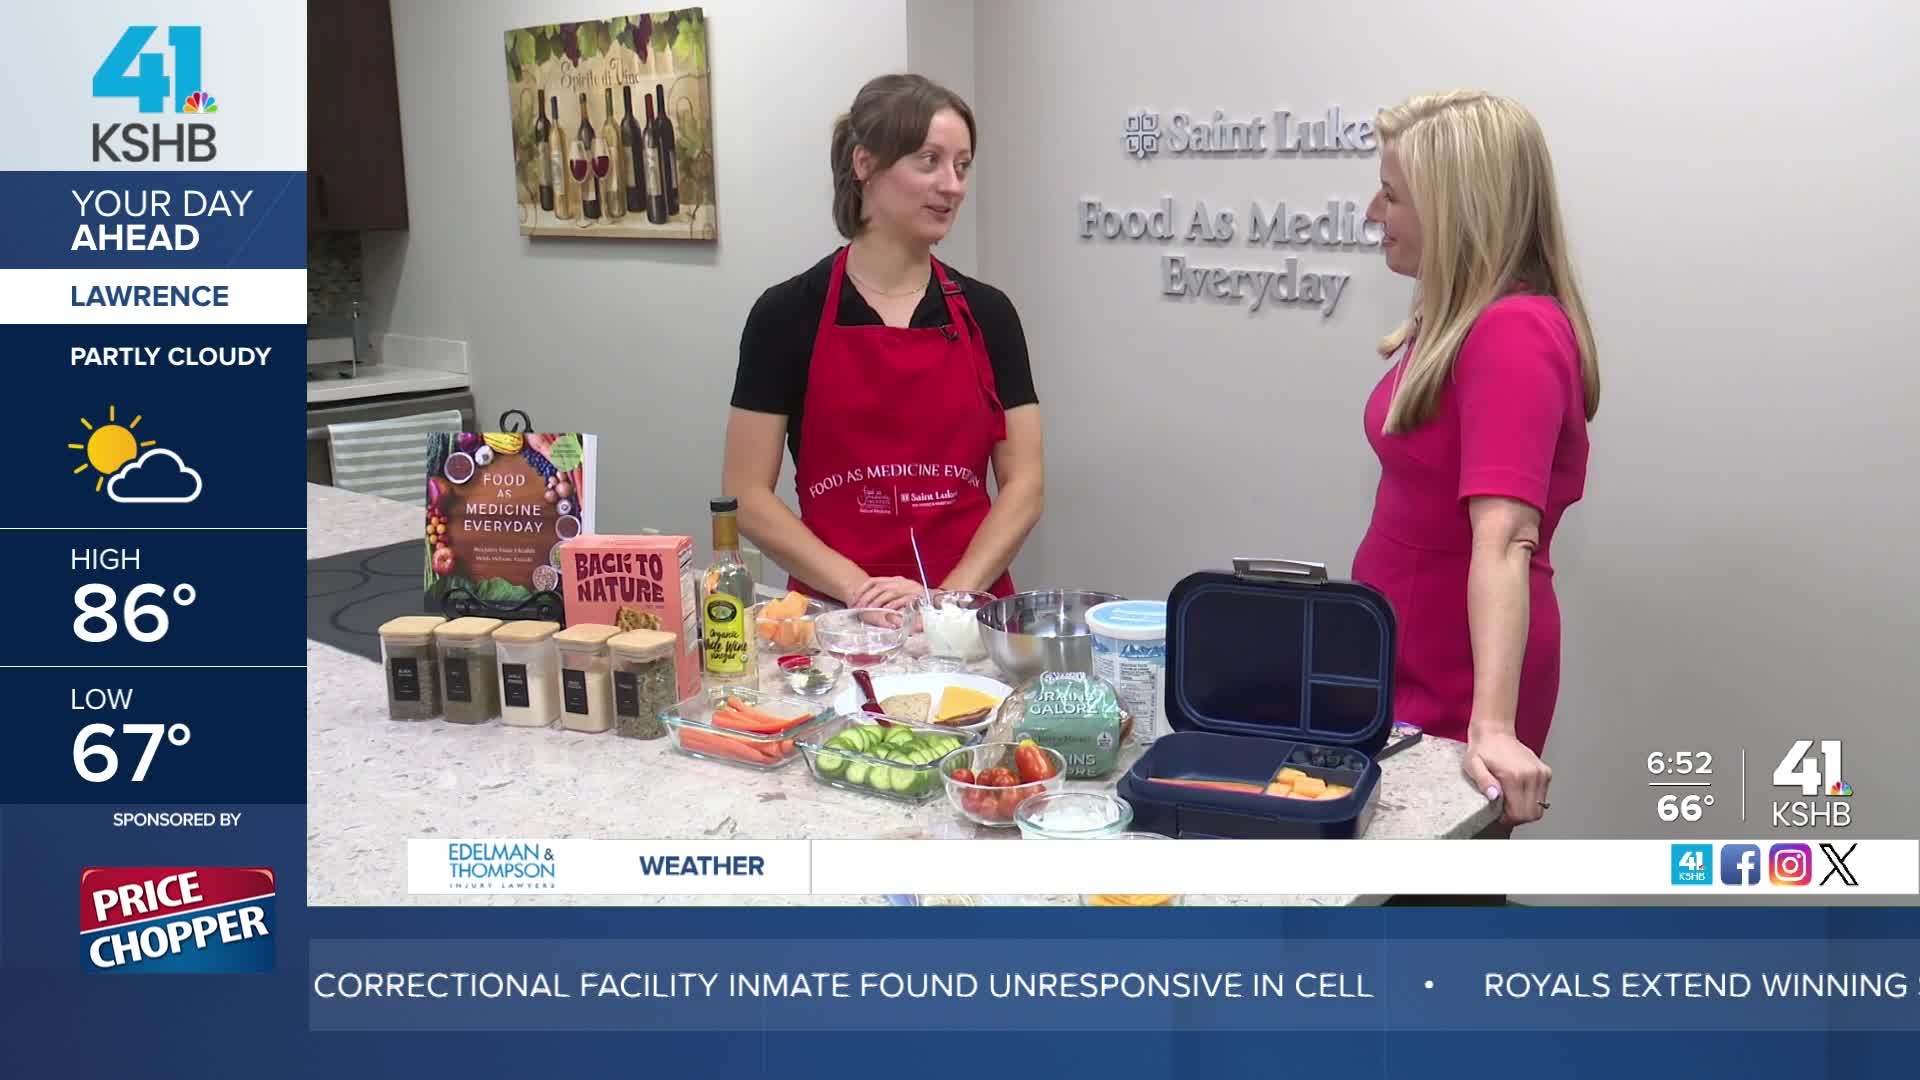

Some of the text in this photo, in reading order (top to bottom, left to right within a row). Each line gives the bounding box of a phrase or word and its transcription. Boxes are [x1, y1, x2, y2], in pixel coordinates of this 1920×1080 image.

[1167, 106, 1380, 153] Saint Luke
[1078, 198, 1383, 247] Food As Medic
[1161, 255, 1350, 317] Everyday
[483, 473, 526, 486] FOOD
[809, 474, 844, 499] FOOD
[847, 468, 864, 484] AS
[866, 463, 940, 479] MEDICINE
[496, 489, 512, 498] AS
[466, 503, 542, 516] MEDICINE
[464, 519, 543, 533] EVERYDAY
[574, 553, 663, 581] BACK TO
[577, 577, 665, 602] NATURE
[710, 629, 739, 642] Organic
